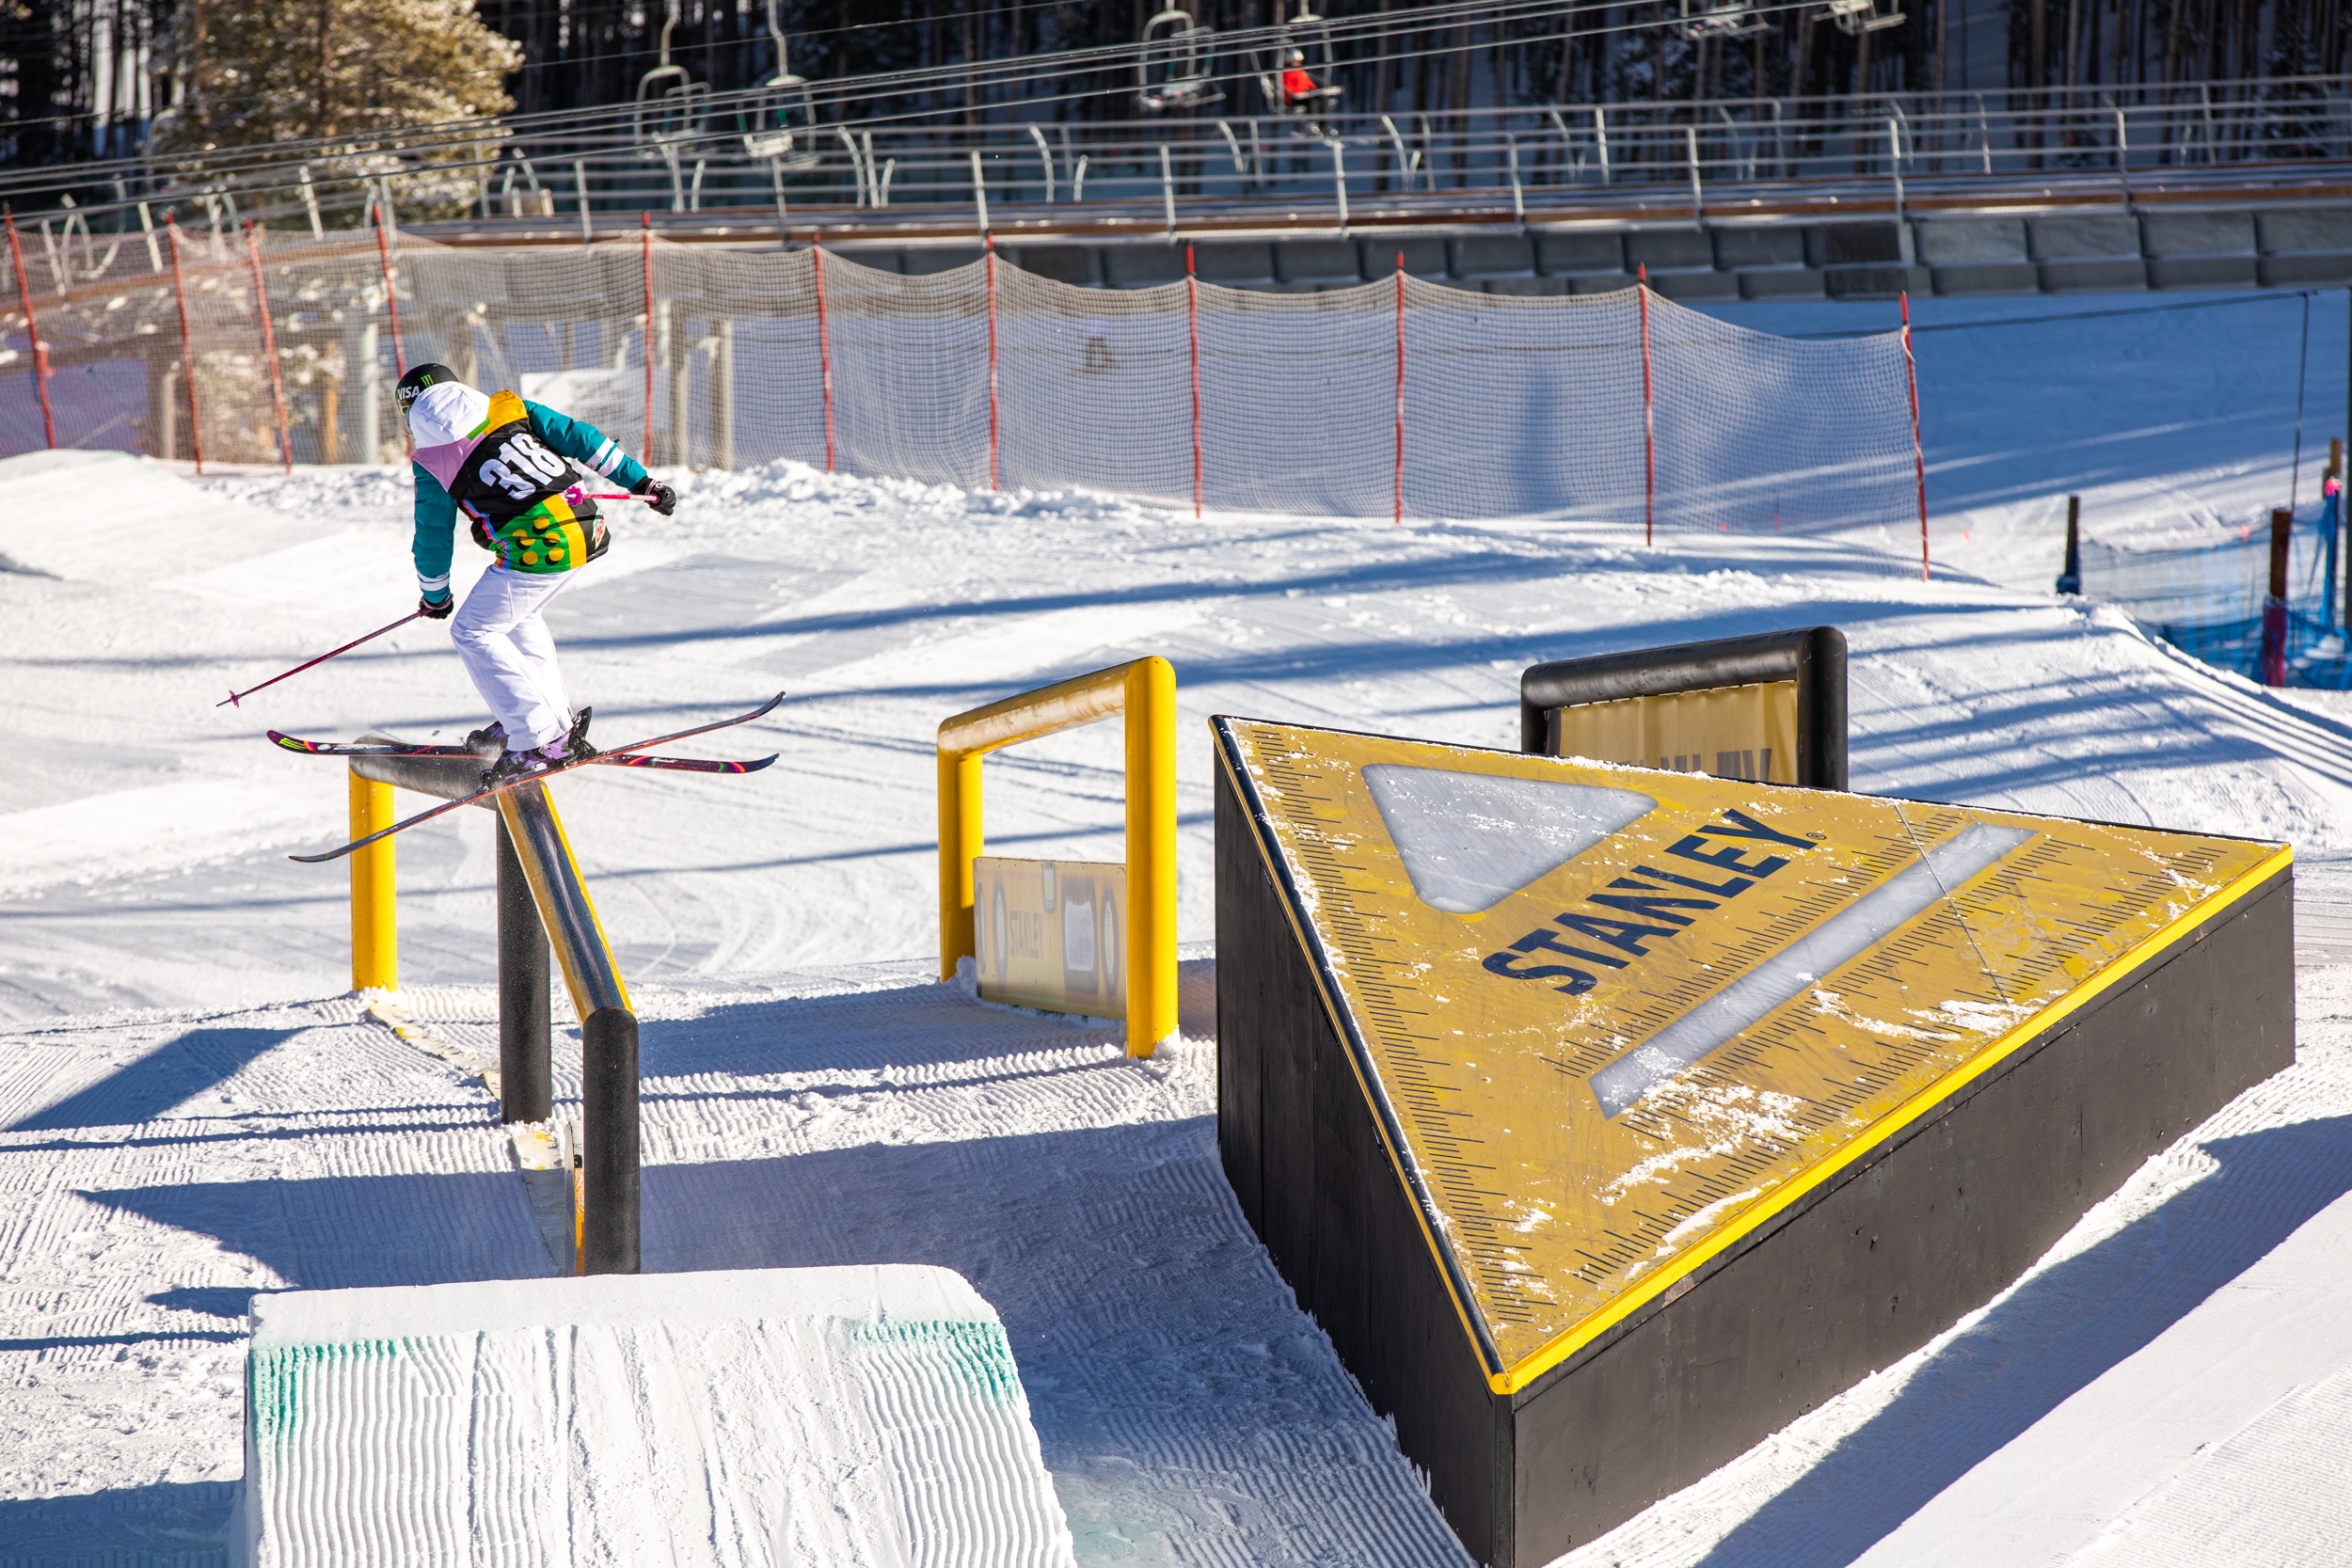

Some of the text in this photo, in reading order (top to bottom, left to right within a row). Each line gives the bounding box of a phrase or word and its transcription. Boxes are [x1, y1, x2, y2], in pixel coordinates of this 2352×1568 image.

[397, 386, 421, 401] VISA
[479, 433, 566, 499] 318
[1482, 808, 1818, 996] STANLEY
[1009, 910, 1043, 959] STANLEY
